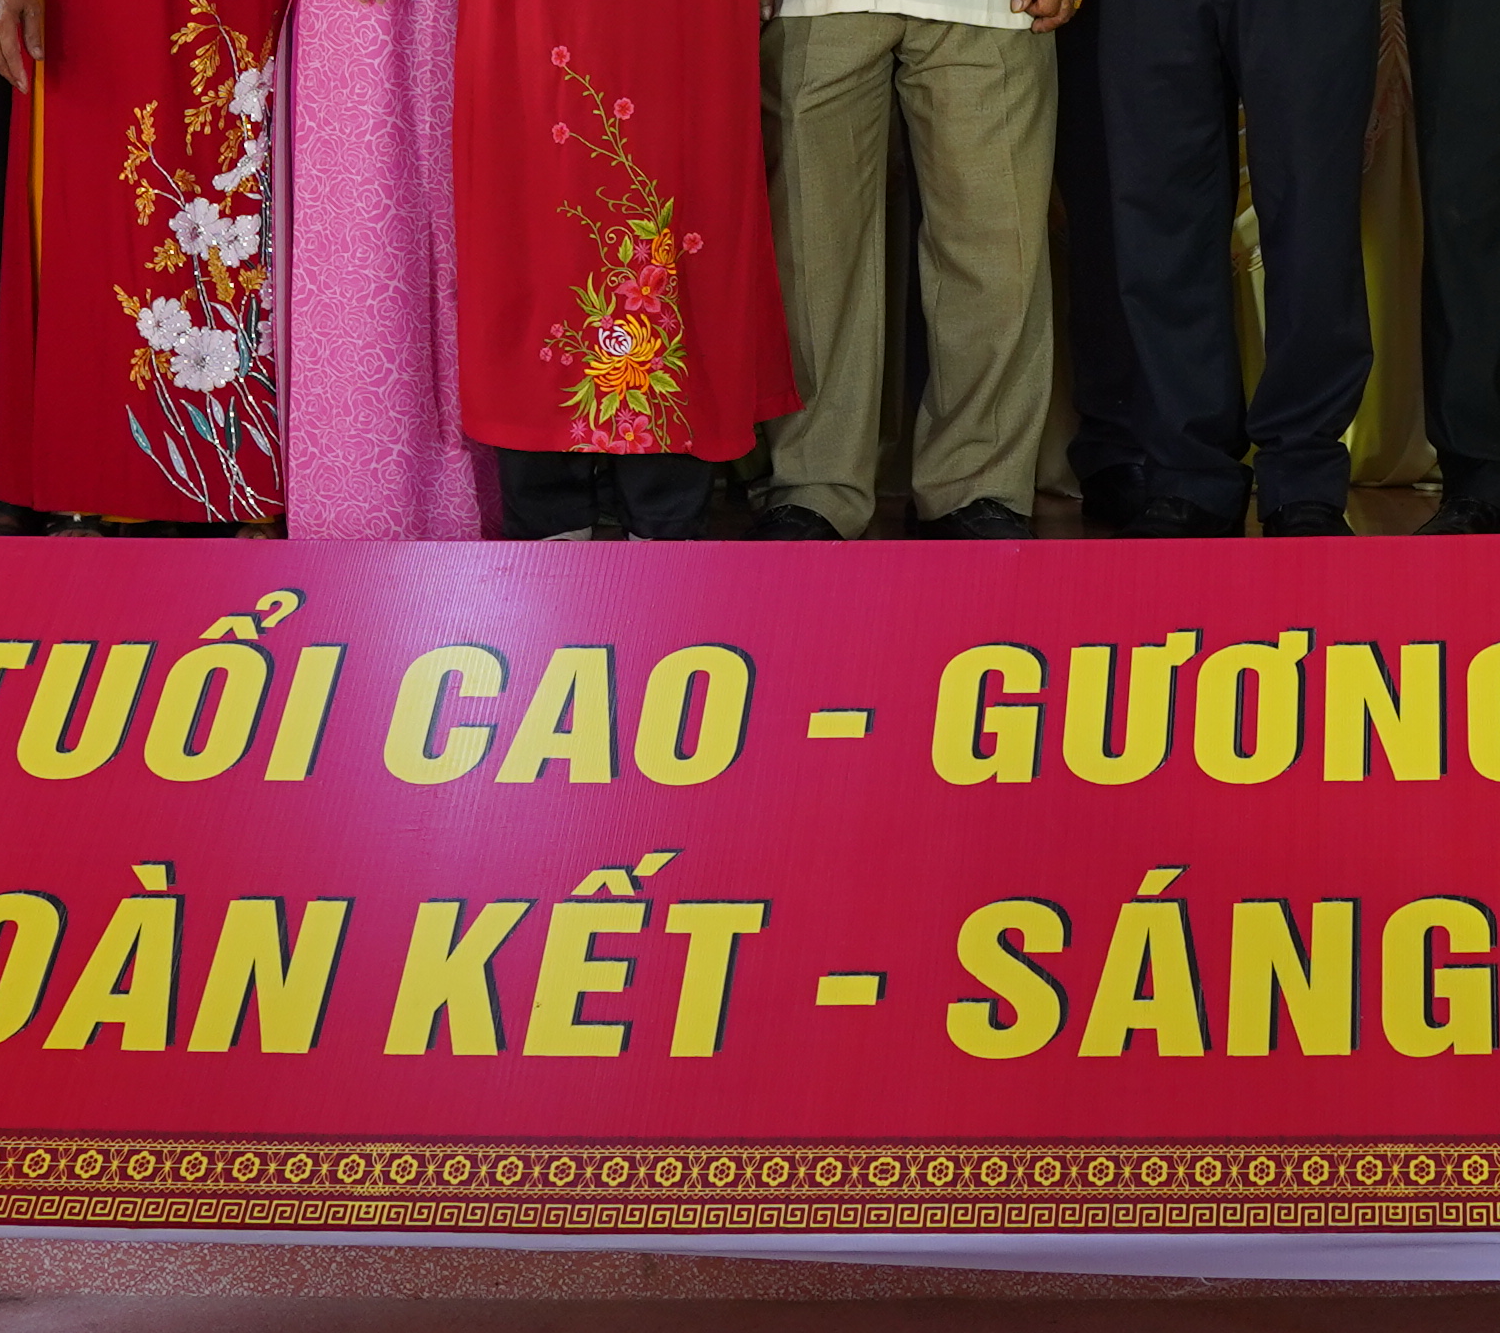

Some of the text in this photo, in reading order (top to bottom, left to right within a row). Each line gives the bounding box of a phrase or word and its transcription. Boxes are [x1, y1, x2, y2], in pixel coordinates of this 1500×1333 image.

[383, 644, 752, 786] CAO
[809, 712, 868, 739] -
[384, 851, 769, 1058] KẾT
[816, 974, 881, 1008] -
[947, 867, 1496, 1060] SÁNG
